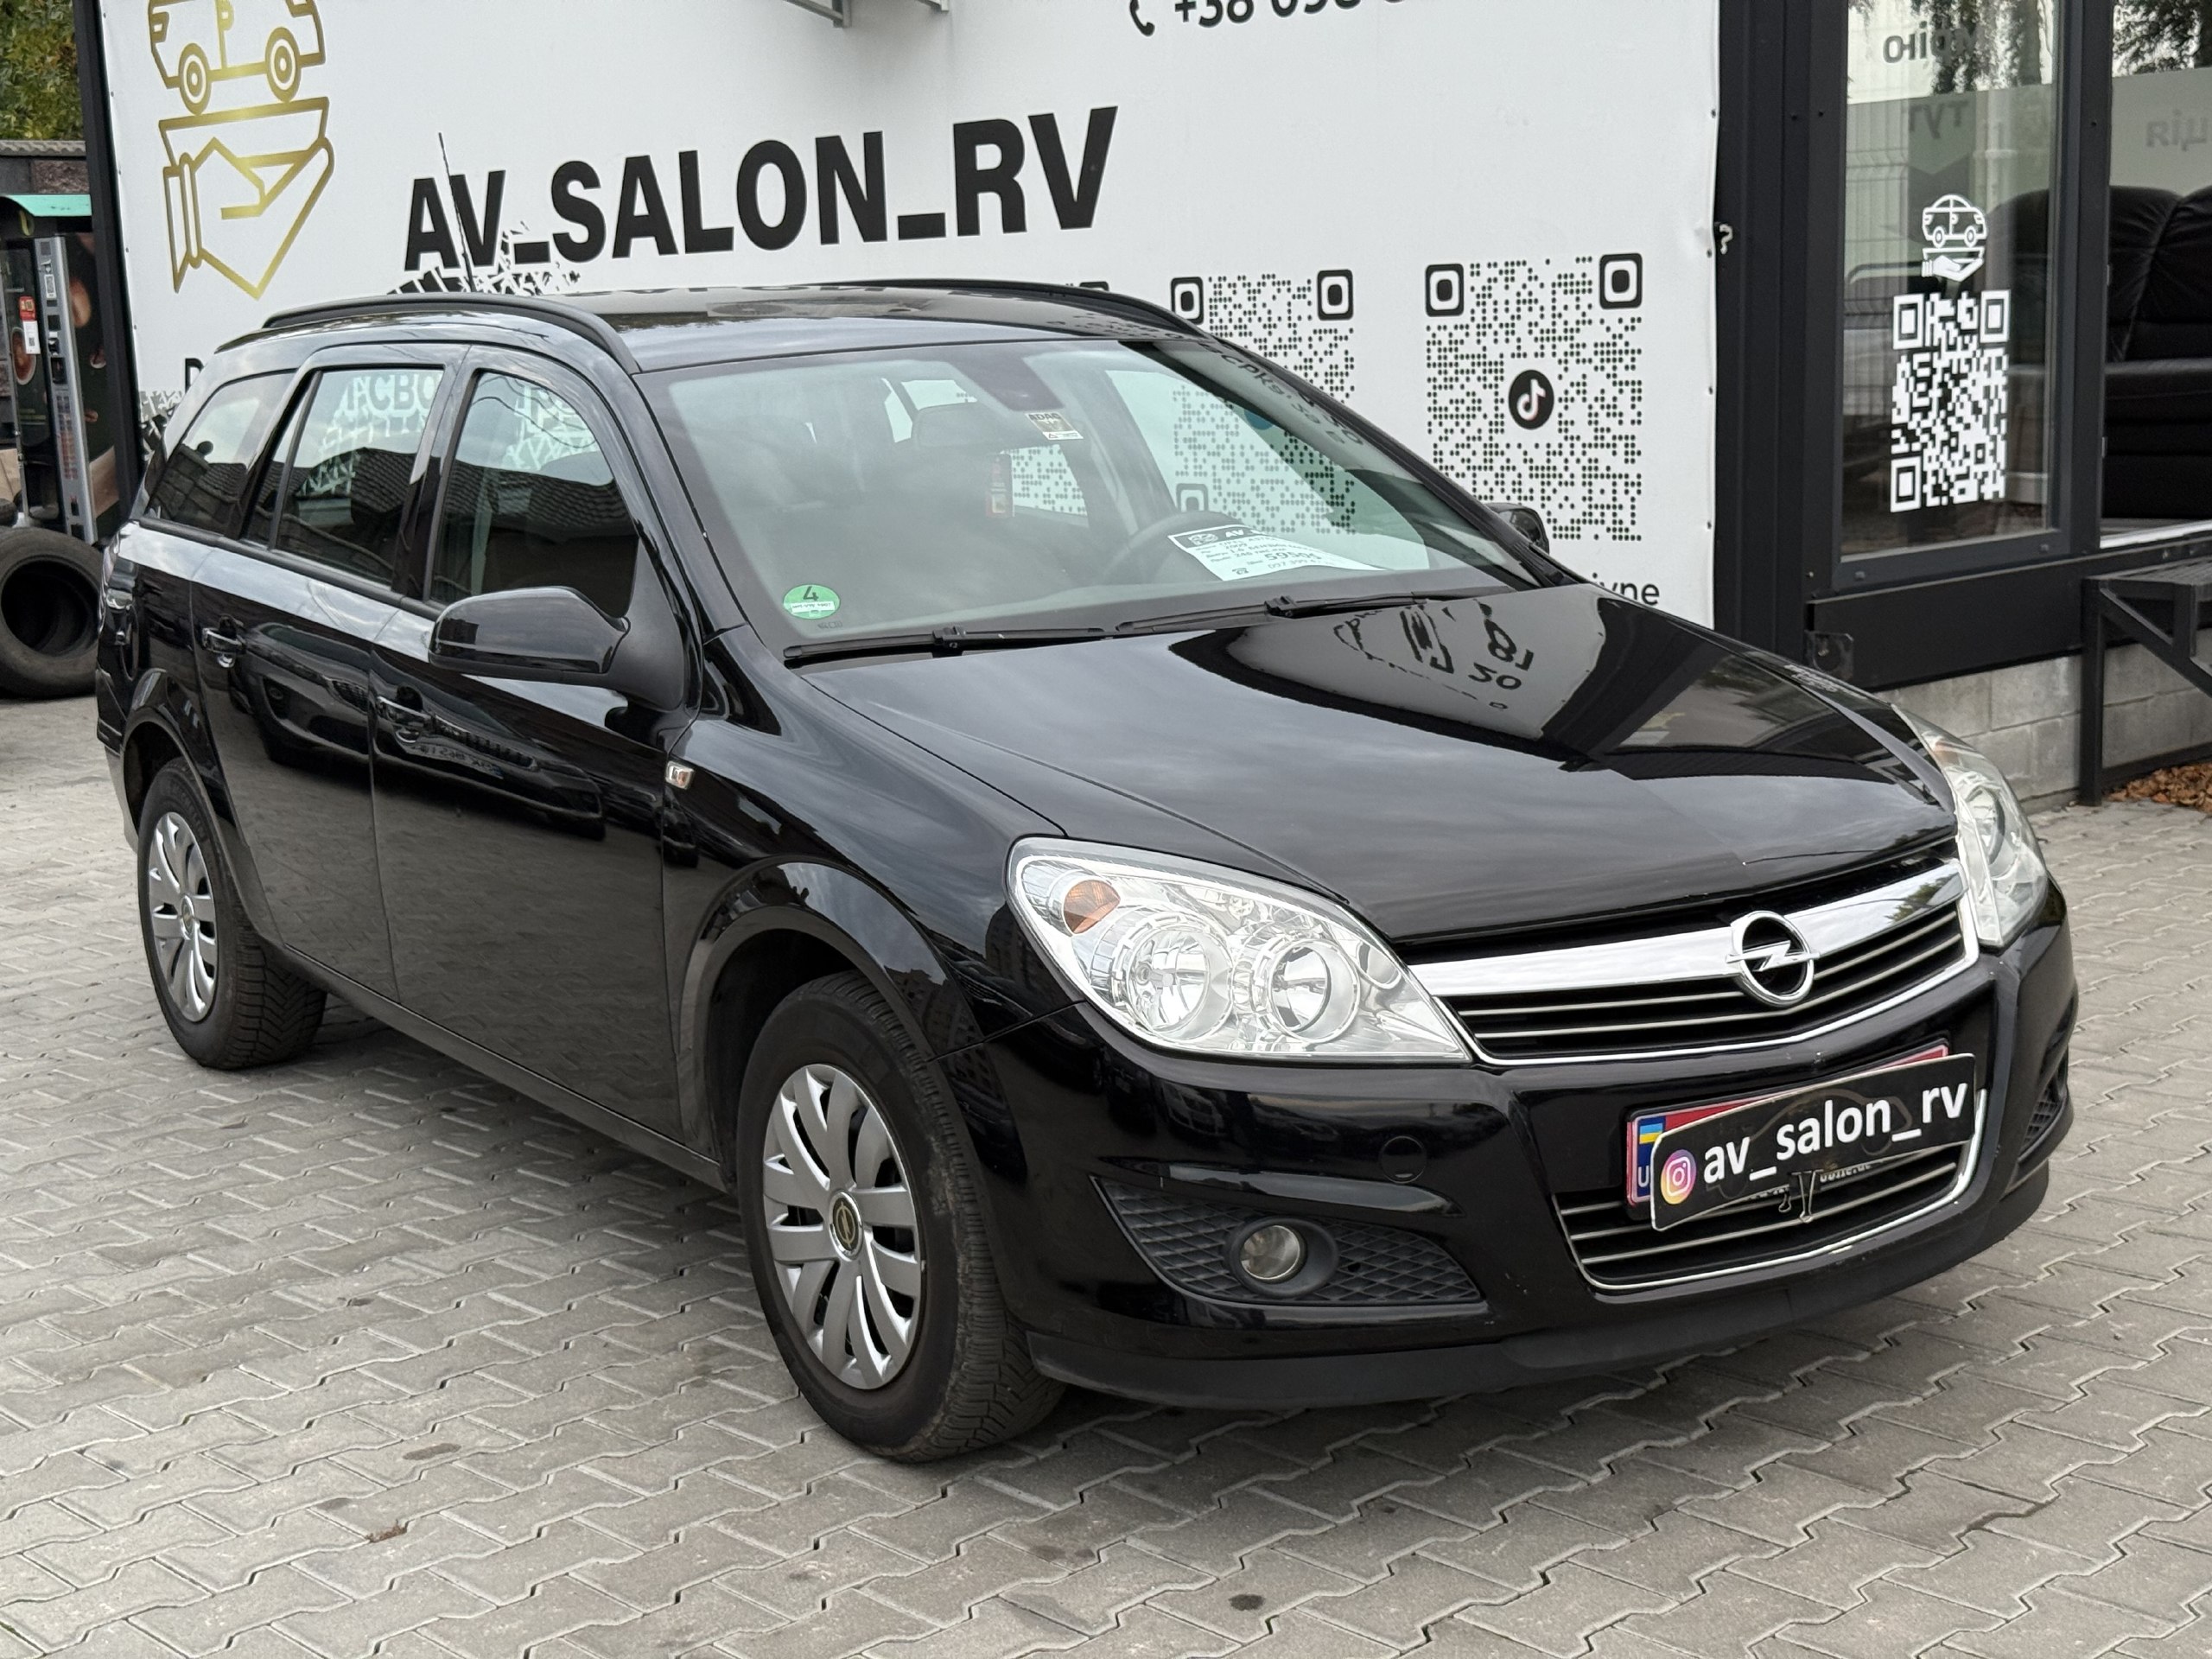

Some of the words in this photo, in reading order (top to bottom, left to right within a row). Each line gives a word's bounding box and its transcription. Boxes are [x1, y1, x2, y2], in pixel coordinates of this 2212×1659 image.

[404, 105, 1118, 270] AV_SALON_RV
[803, 586, 818, 601] 4
[1703, 1083, 1968, 1184] av_salon_rv
